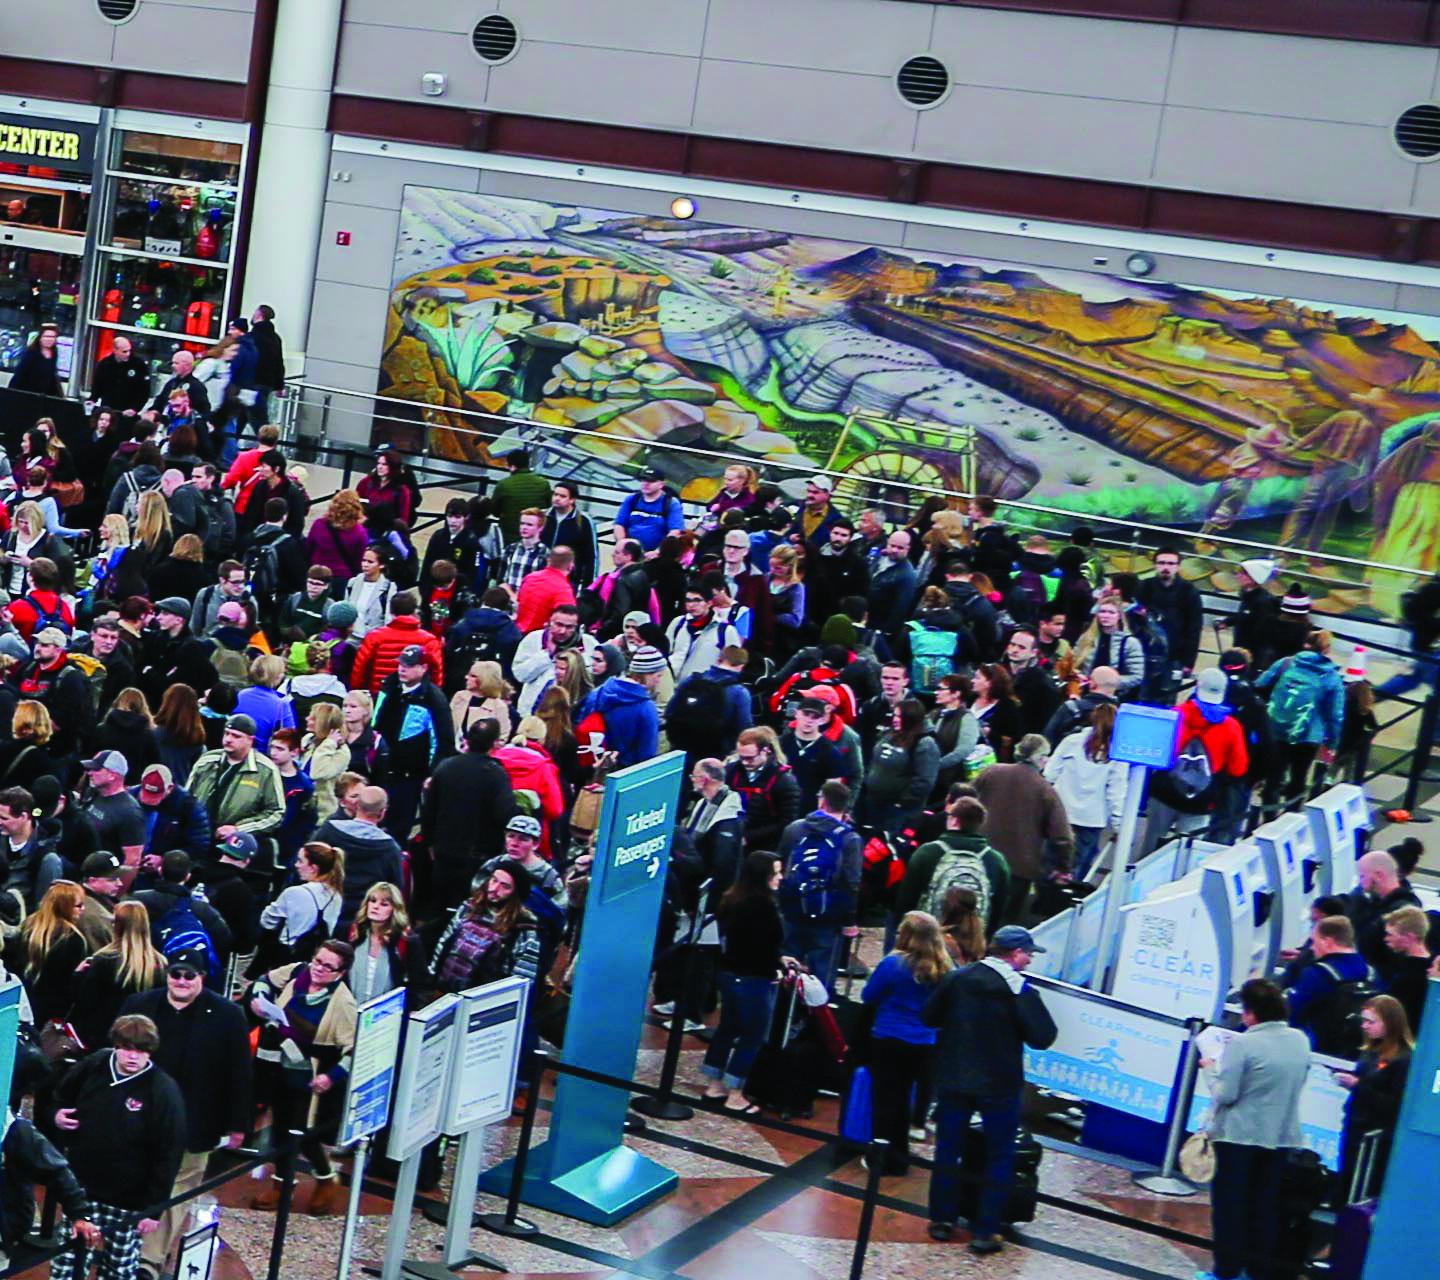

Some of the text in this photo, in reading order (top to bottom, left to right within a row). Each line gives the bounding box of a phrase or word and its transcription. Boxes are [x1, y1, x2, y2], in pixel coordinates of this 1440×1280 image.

[1117, 743, 1162, 761] CLEAR
[625, 802, 668, 838] Ticketed
[613, 833, 667, 868] Passengers
[1133, 949, 1215, 982] CLEAR
